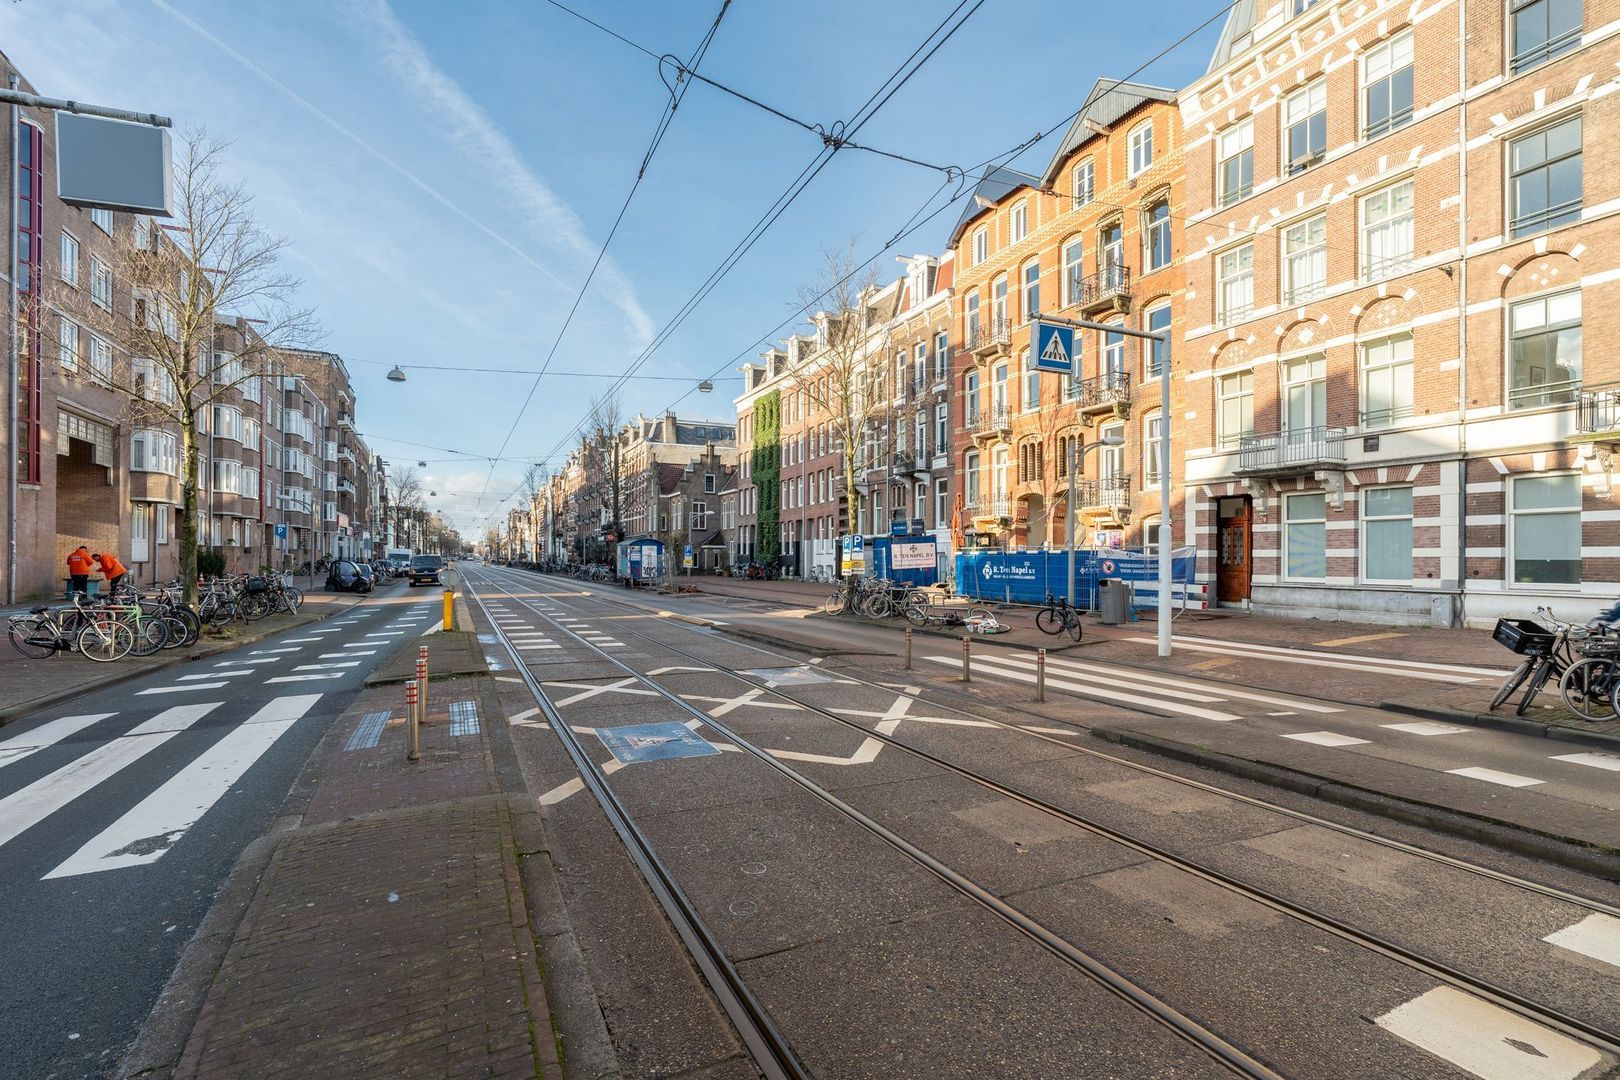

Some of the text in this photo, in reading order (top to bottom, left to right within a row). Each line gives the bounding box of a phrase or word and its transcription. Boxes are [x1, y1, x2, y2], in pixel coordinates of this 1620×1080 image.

[844, 538, 850, 546] P
[854, 536, 861, 546] P
[1011, 566, 1028, 575] Napel
